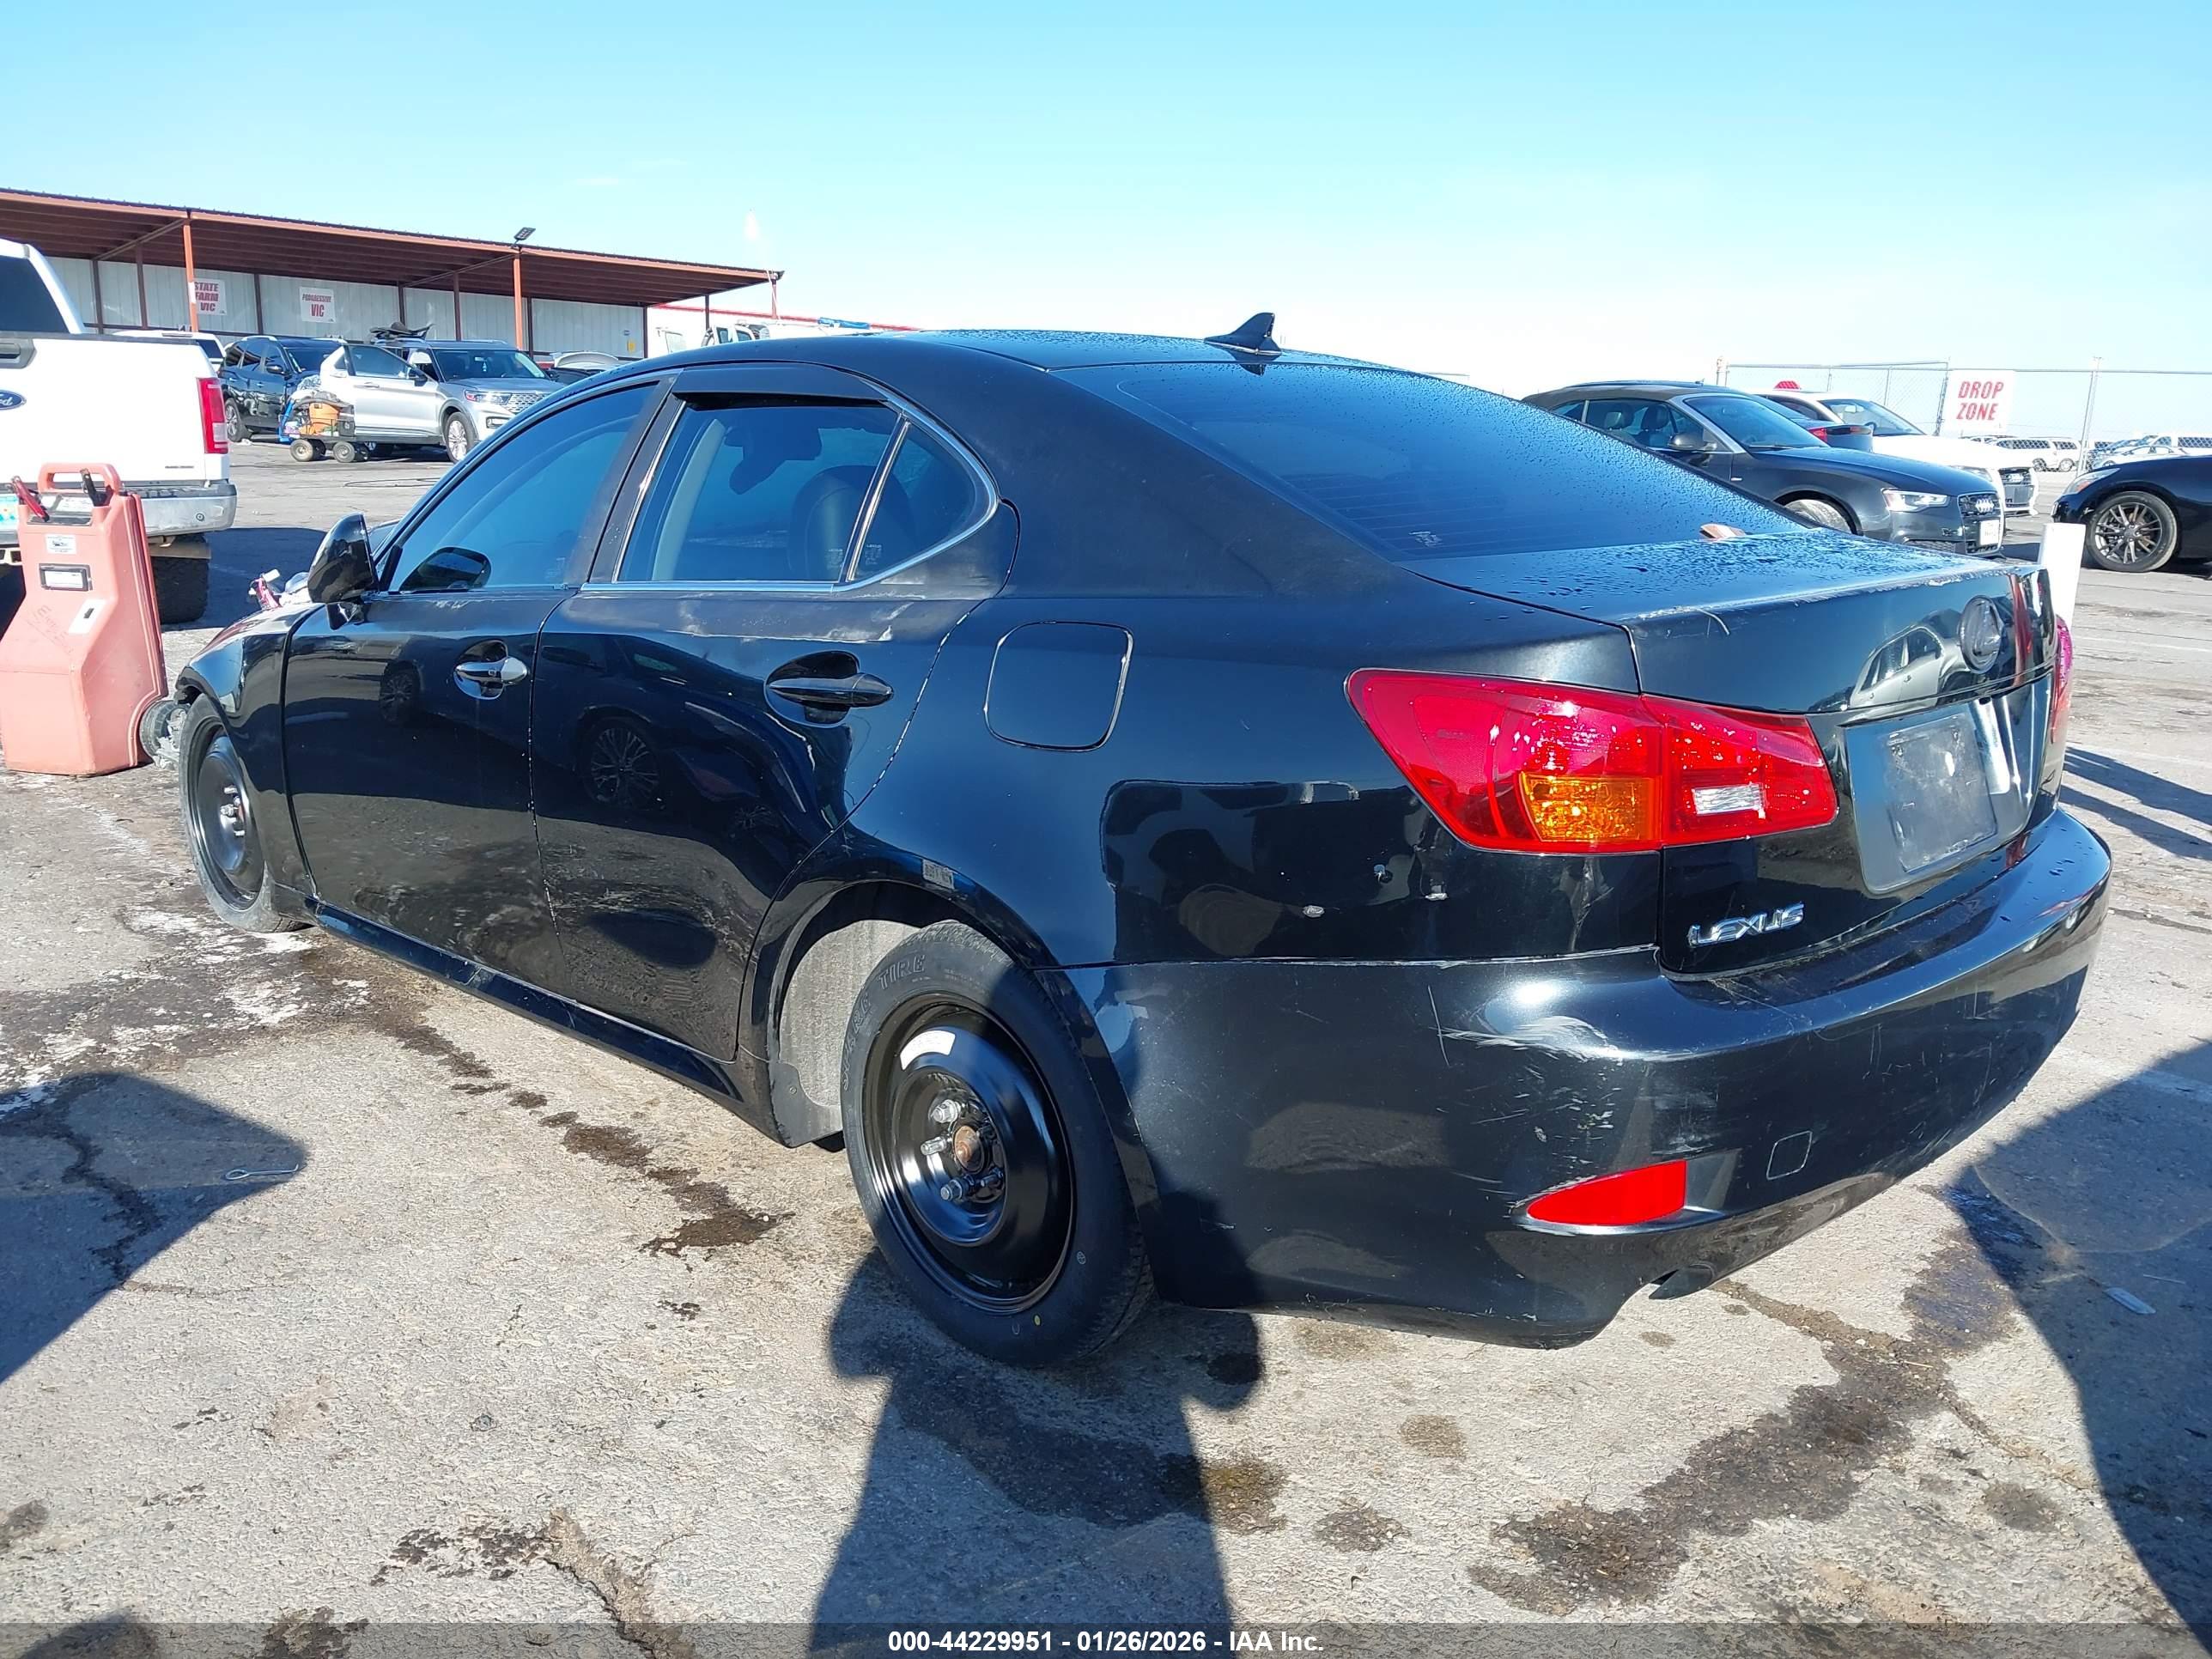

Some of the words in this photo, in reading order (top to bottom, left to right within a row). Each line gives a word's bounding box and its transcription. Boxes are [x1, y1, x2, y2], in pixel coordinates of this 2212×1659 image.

[194, 282, 218, 292] STATE
[195, 292, 219, 302] FARM
[200, 302, 216, 312] VIC
[311, 304, 325, 317] VIC
[1958, 381, 2004, 399] DROP
[1956, 403, 1999, 421] ZONE
[1687, 902, 1804, 948] LEXUS
[878, 954, 926, 990] TIRE
